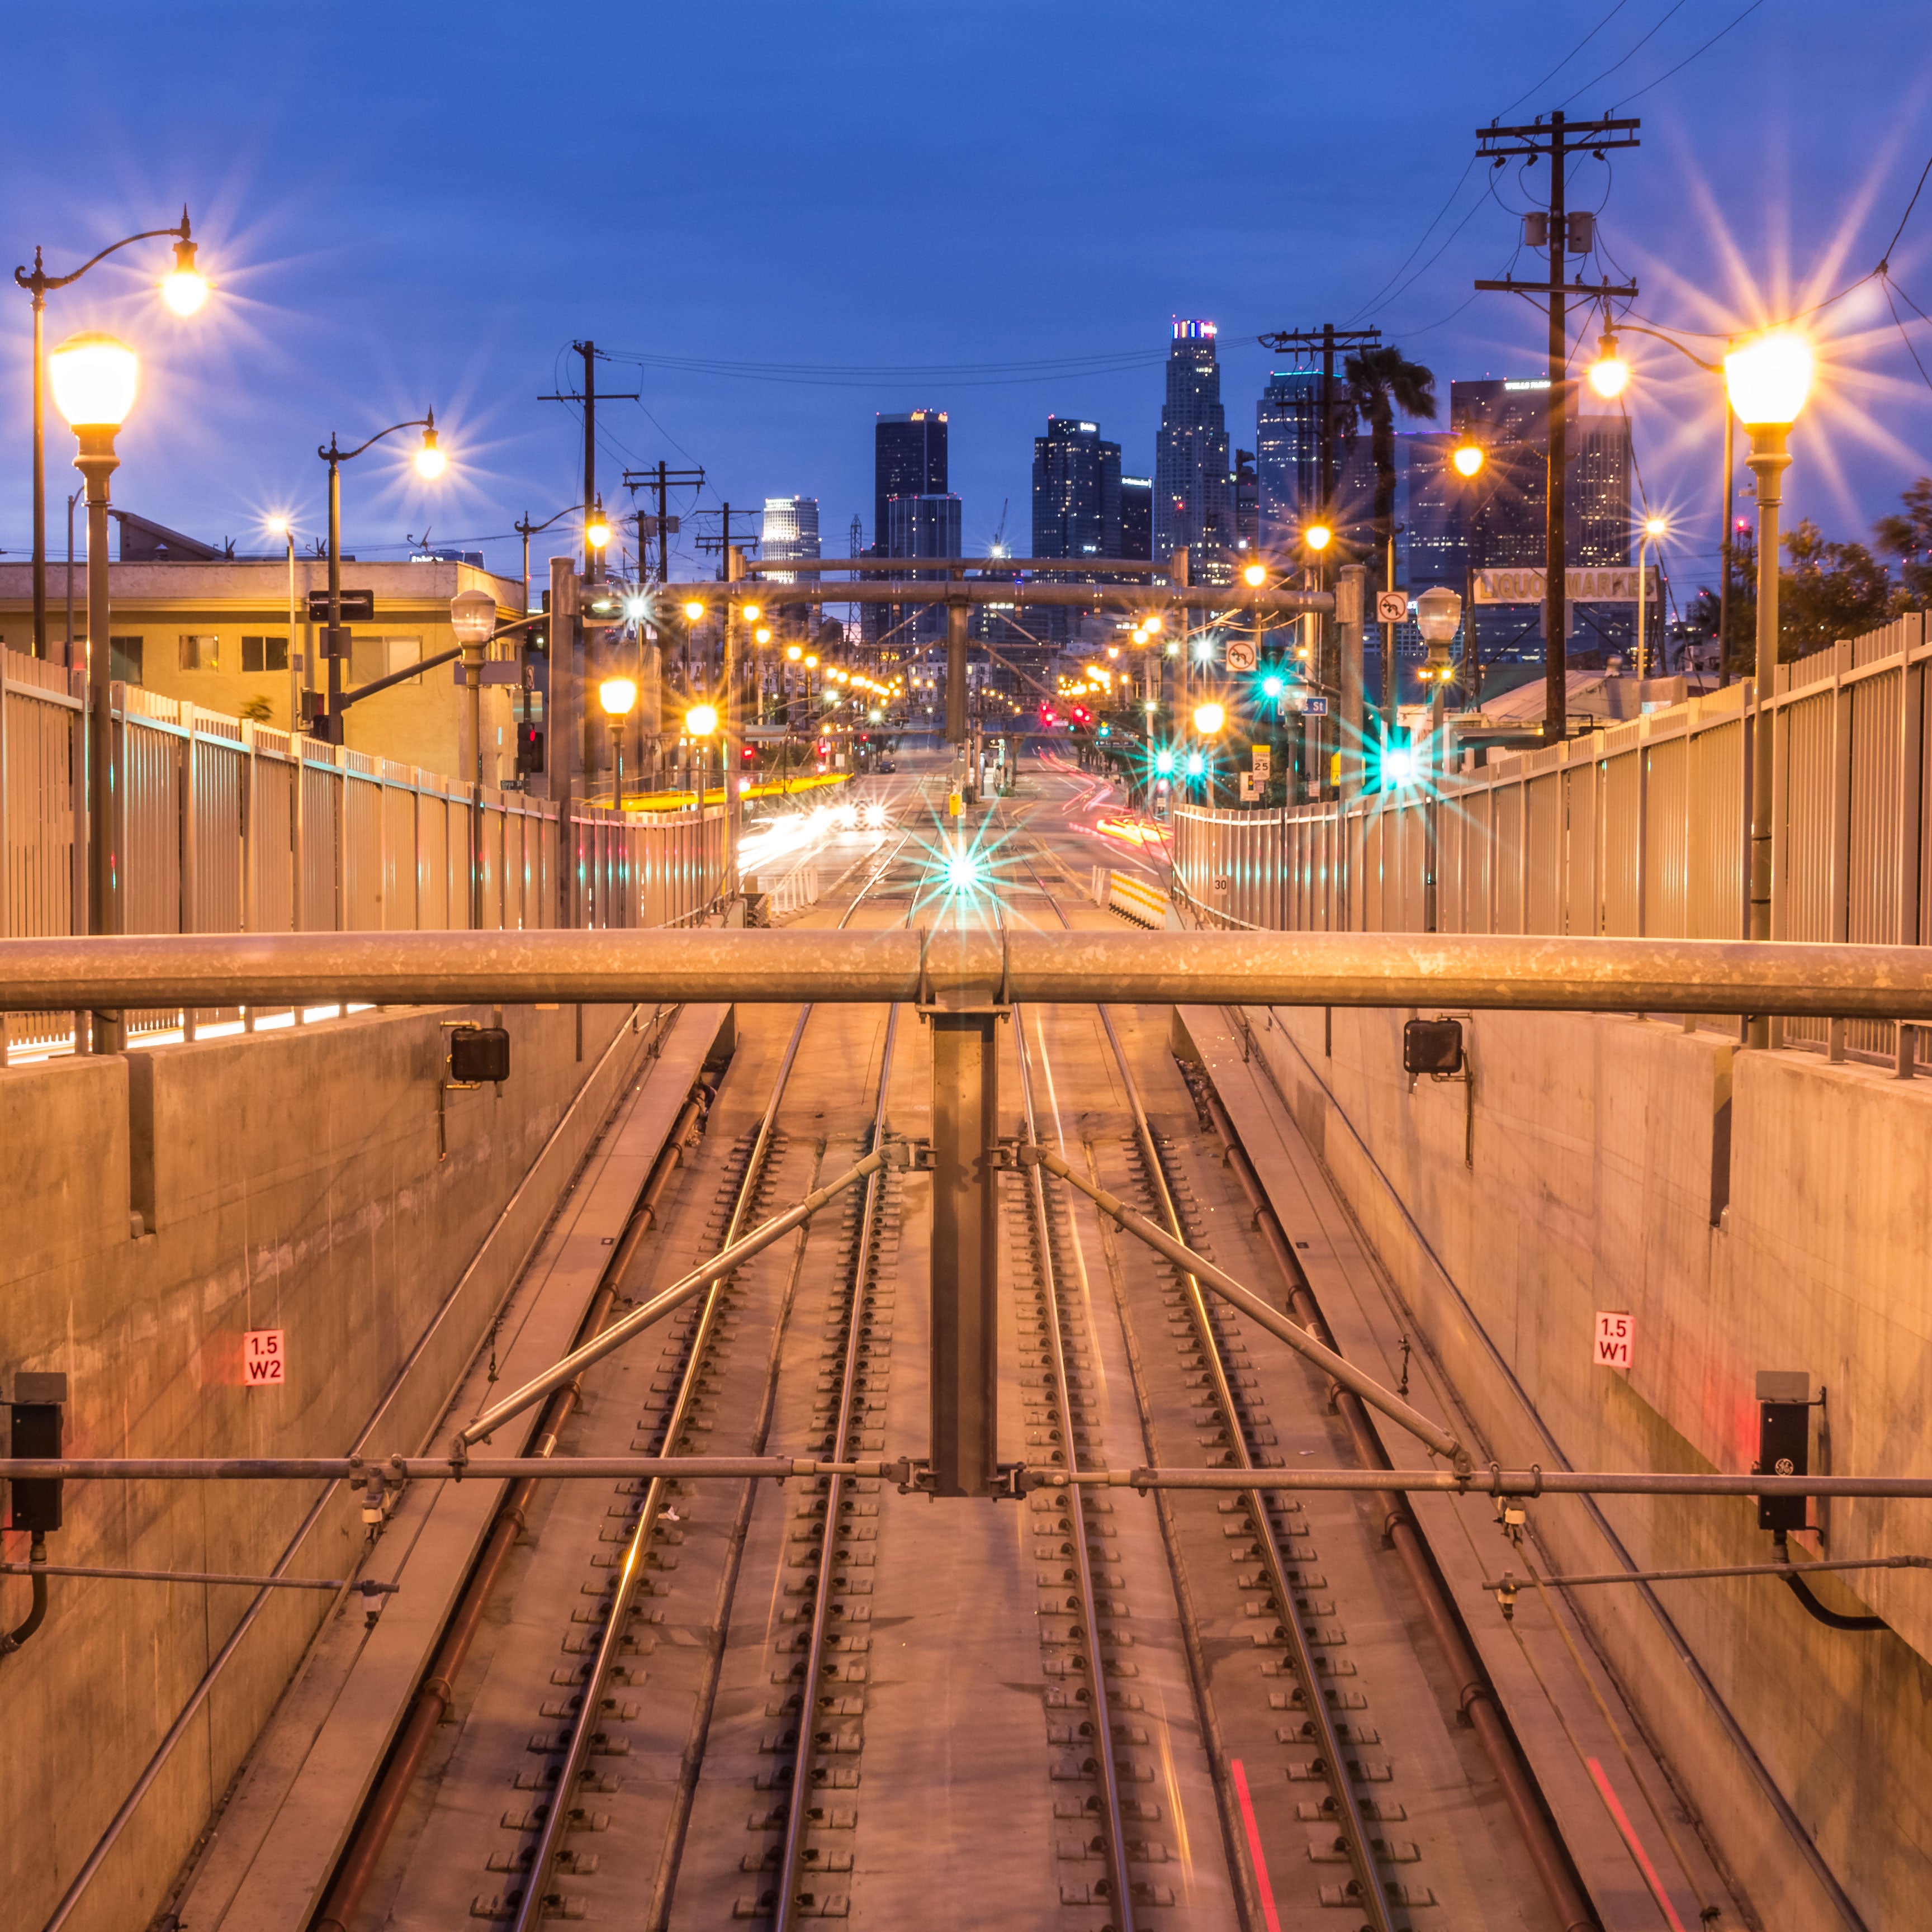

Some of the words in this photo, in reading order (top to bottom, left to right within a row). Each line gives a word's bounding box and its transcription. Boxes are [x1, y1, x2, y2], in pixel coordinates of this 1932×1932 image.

[1480, 573, 1547, 599] LIQUO
[1313, 702, 1323, 712] St
[1215, 880, 1227, 889] 30
[1602, 1318, 1627, 1337] 1.5
[252, 1336, 277, 1355] 1.5
[1599, 1341, 1627, 1362] W1
[249, 1360, 281, 1379] W2
